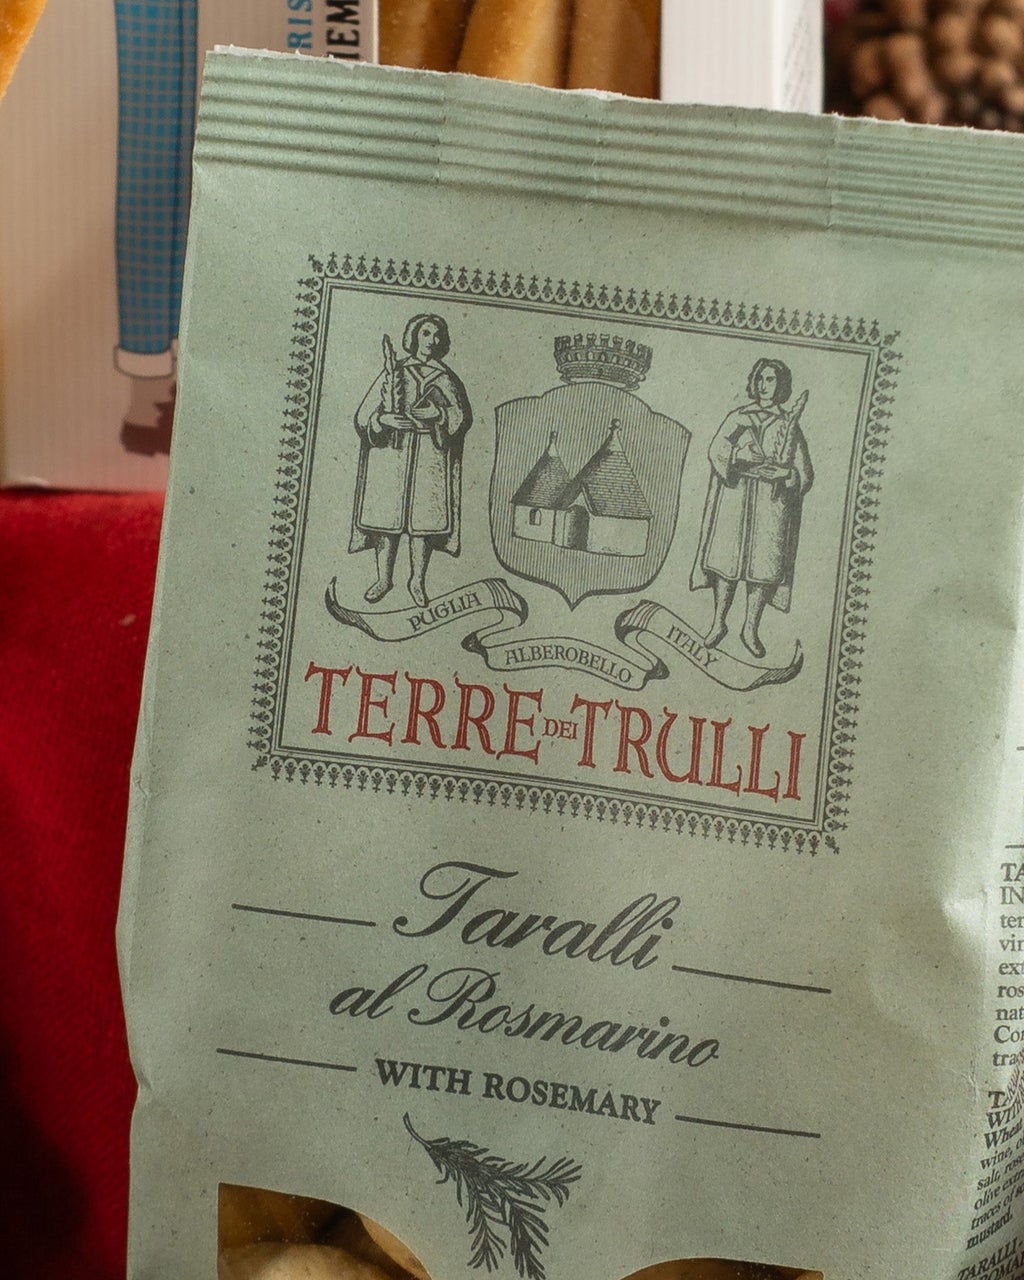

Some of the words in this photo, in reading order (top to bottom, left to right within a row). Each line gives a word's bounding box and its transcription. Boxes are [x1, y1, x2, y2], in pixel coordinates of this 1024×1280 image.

[407, 591, 482, 633] PUGLIA
[504, 643, 634, 685] ALBEROBELLO
[665, 624, 720, 669] ITALY
[304, 660, 545, 766] TERRE
[541, 715, 579, 741] DEI
[569, 693, 808, 803] TRULLI
[391, 860, 682, 971] Taralli
[327, 963, 429, 1020] al
[407, 966, 720, 1068] Rosmarino
[375, 1058, 473, 1097] WITH
[482, 1072, 662, 1126] ROSEMARY
[974, 1186, 1001, 1211] olive
